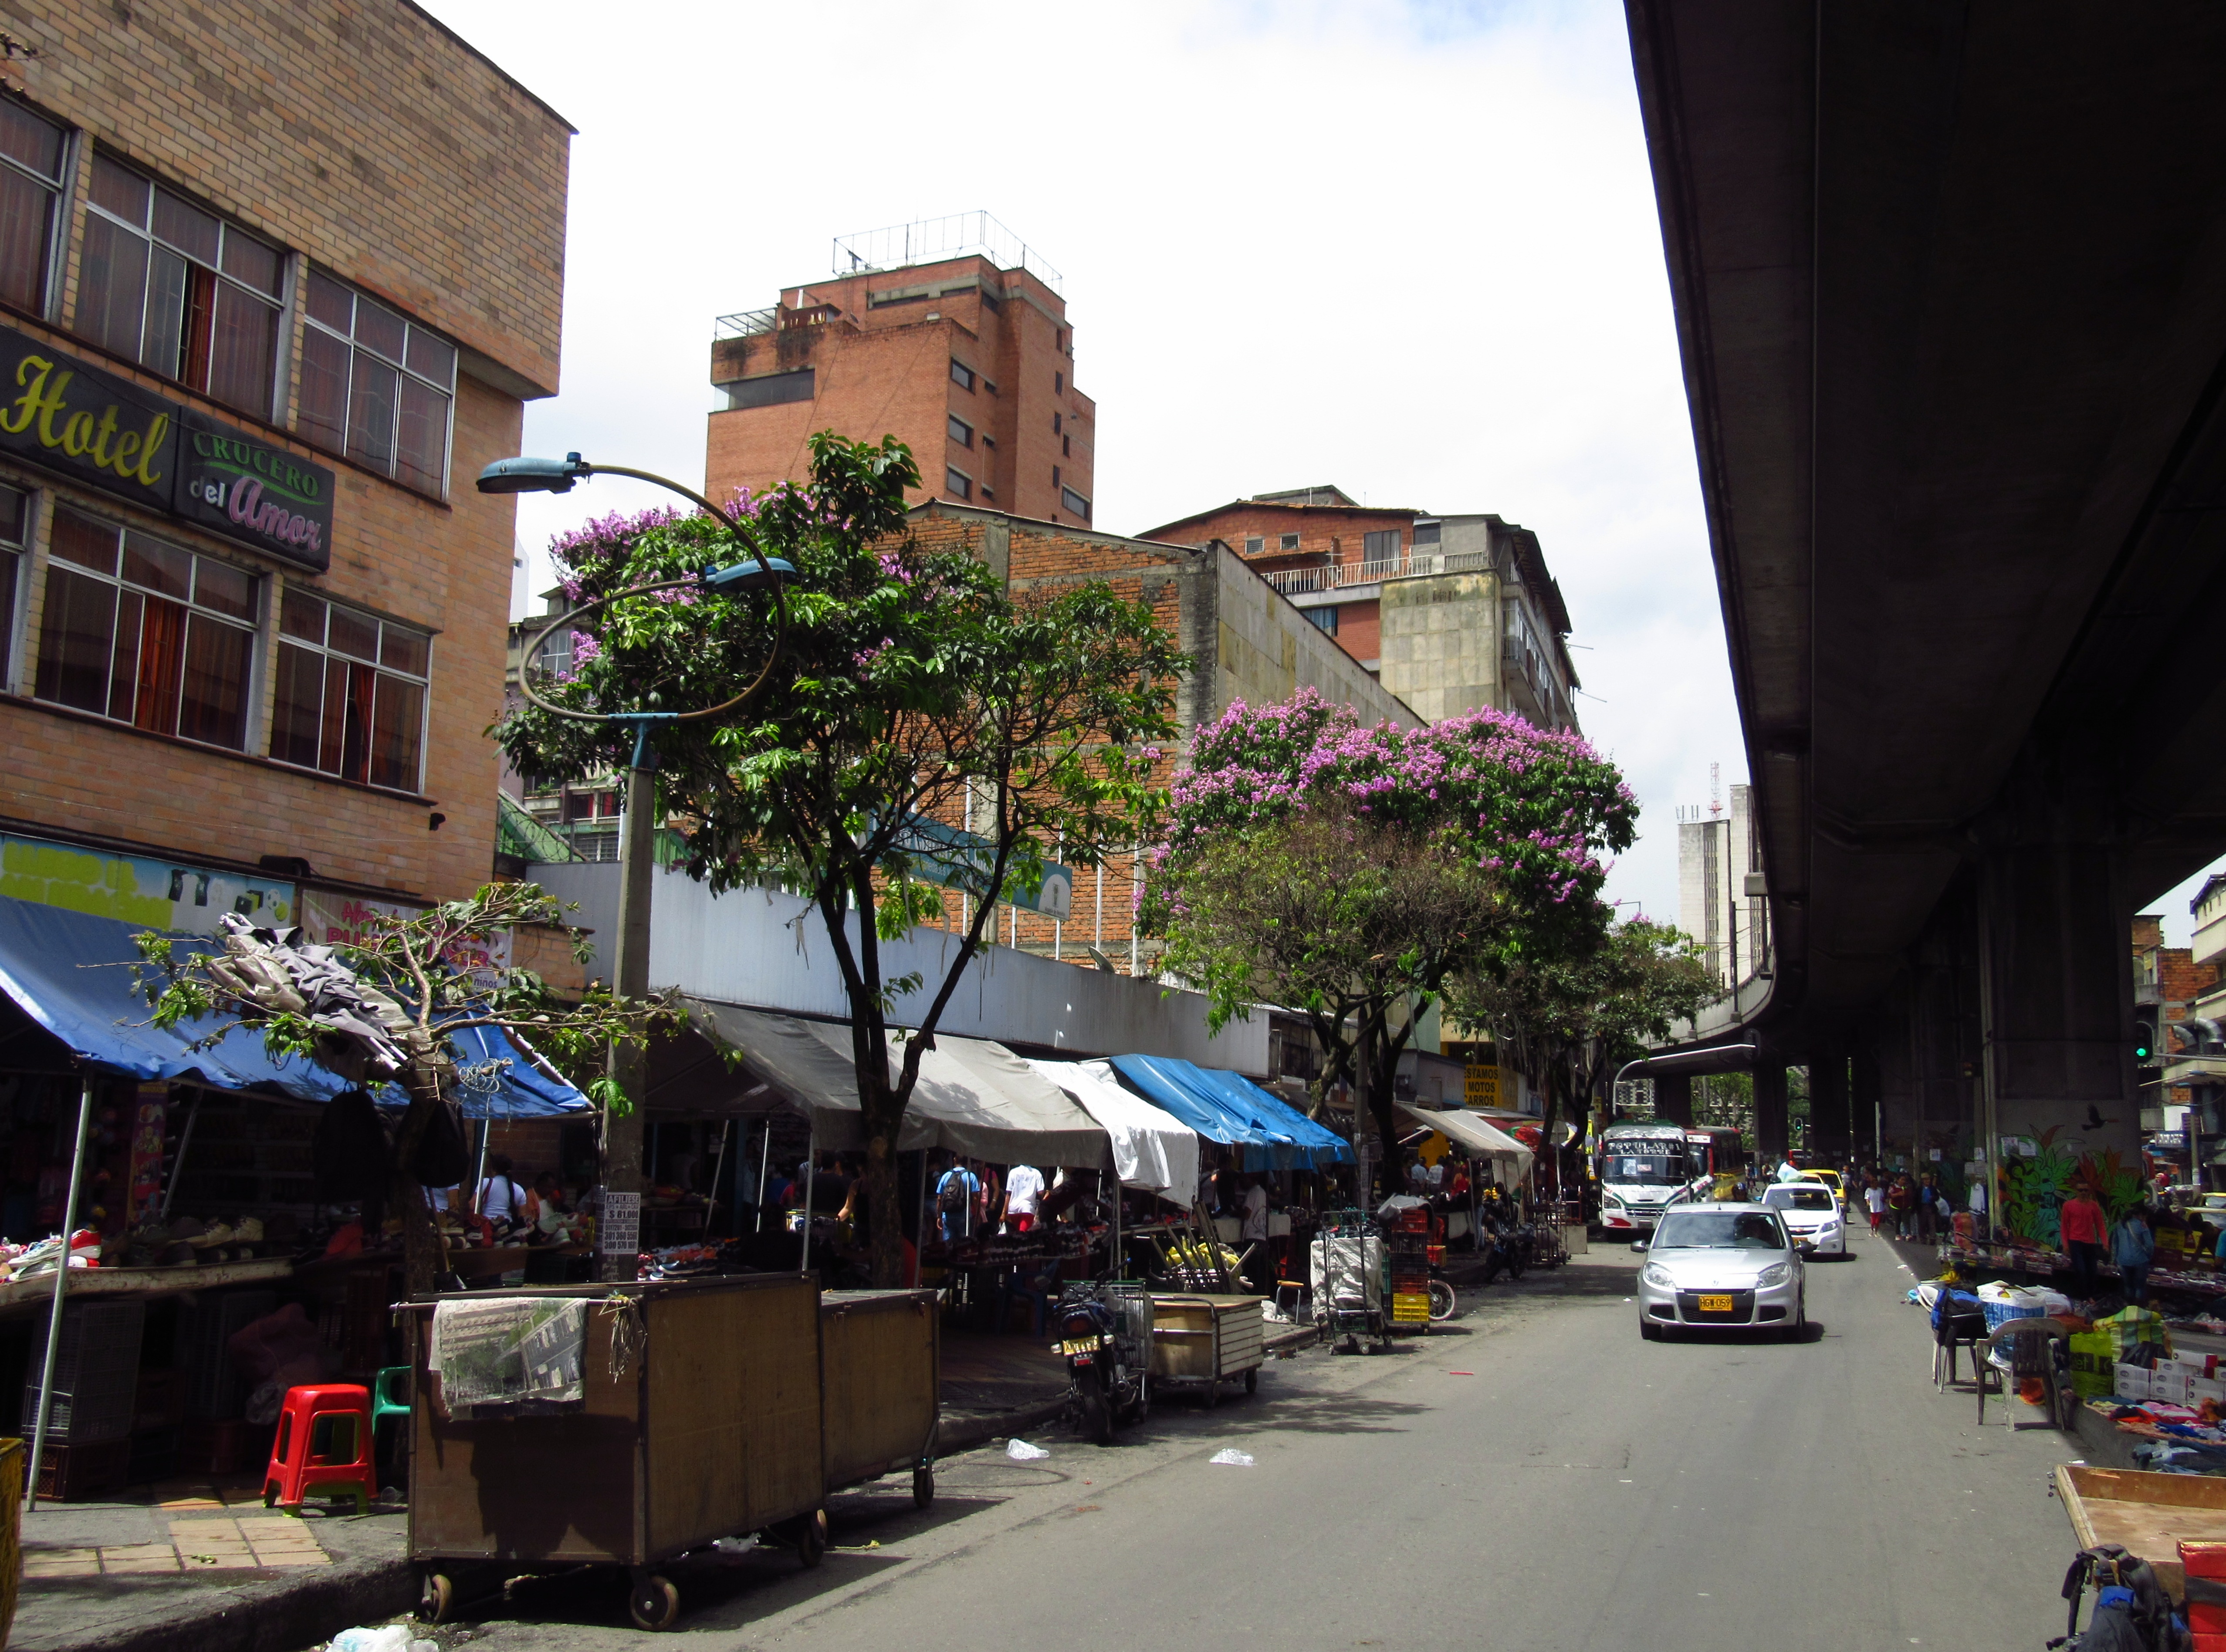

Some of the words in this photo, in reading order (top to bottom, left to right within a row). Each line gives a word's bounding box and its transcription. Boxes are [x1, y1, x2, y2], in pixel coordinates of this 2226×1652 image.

[0, 355, 169, 486] Hotel
[193, 431, 320, 498] CRUCERO
[190, 477, 226, 508] del
[229, 476, 321, 552] Amor
[474, 976, 497, 989] niños
[1468, 1081, 1495, 1093] MOTOS
[608, 1195, 639, 1203] AFILIESE
[609, 1210, 615, 1219] $
[617, 1210, 639, 1219] 81.000
